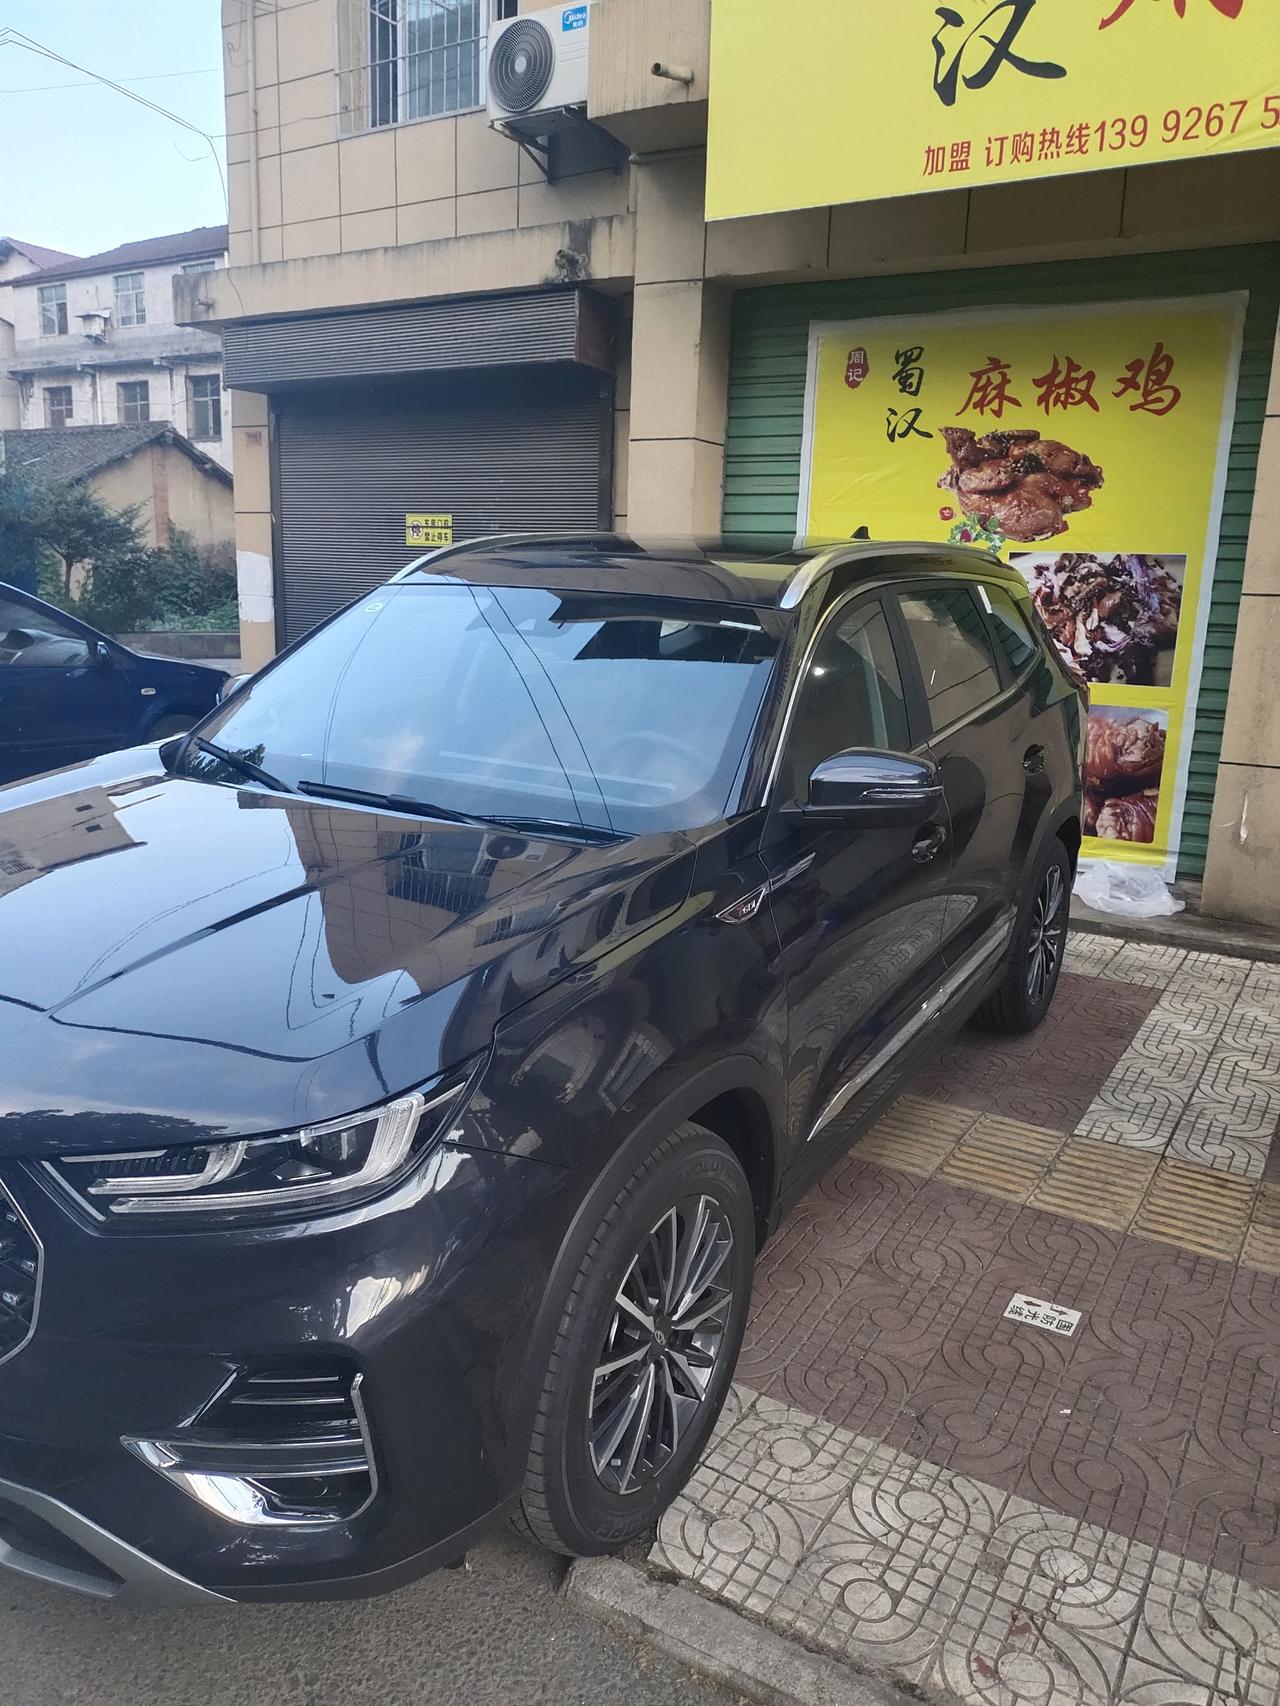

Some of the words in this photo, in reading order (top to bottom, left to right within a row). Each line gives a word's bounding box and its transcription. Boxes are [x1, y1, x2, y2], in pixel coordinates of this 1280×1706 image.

[932, 0, 1067, 107] 汉
[923, 140, 972, 176] 加盟
[1162, 99, 1248, 144] 9267
[848, 350, 865, 382] 周记
[955, 342, 1183, 419] 麻椒鸡
